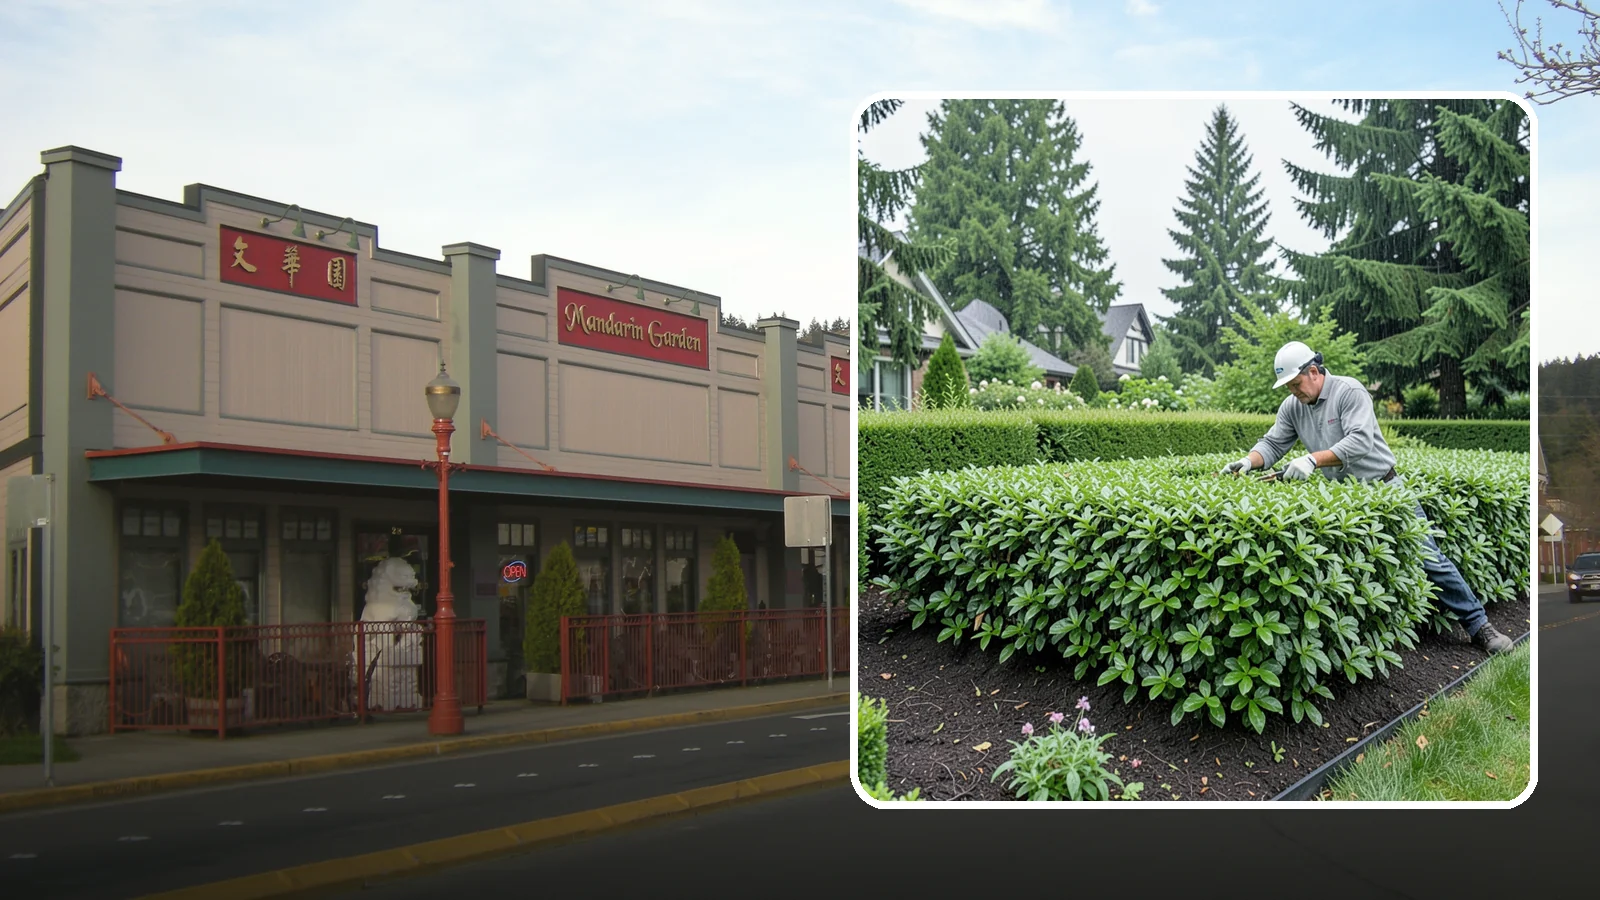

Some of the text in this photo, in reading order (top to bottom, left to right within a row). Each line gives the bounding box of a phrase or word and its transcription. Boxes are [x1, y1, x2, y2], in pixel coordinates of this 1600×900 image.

[231, 235, 346, 291] 文華園
[564, 302, 701, 352] Mandarin Garden
[503, 565, 527, 578] OPEN
